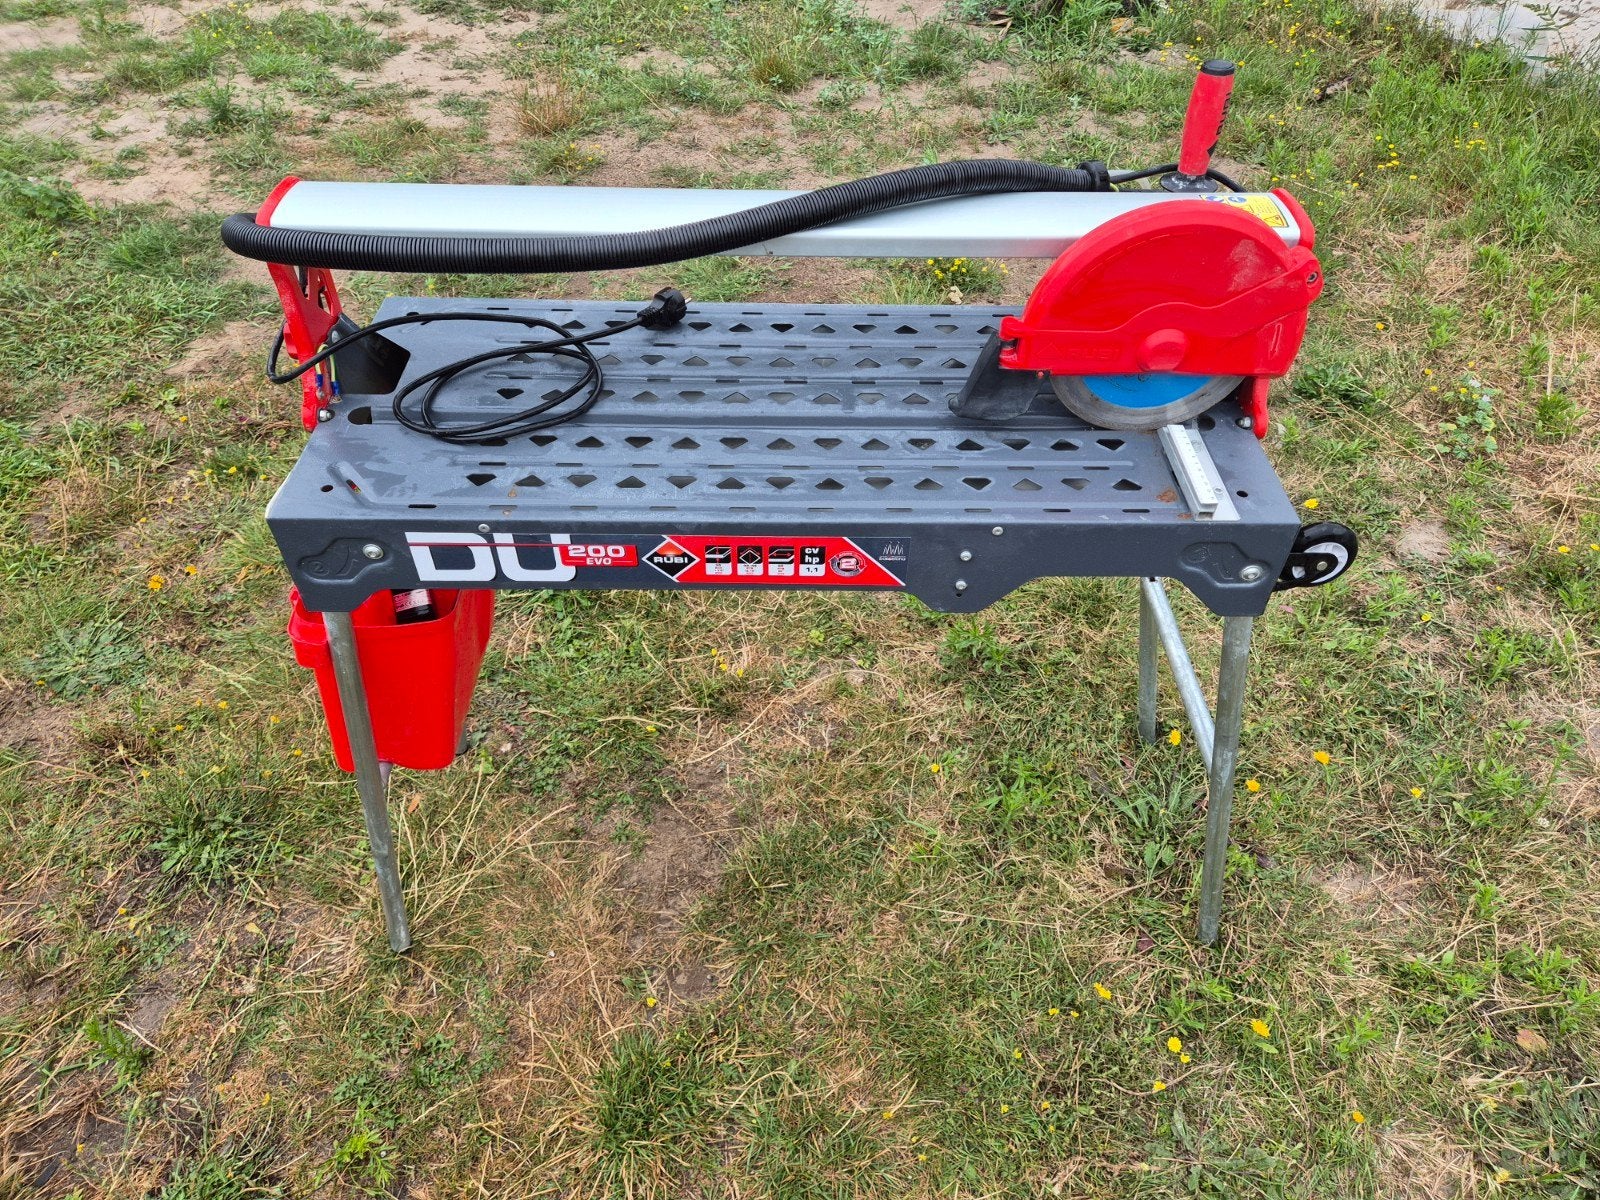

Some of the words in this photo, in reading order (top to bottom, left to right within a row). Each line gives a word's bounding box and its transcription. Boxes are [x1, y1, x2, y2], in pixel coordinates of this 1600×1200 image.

[568, 545, 625, 558] 200
[404, 532, 576, 582] DU
[586, 557, 612, 565] EVO
[653, 556, 689, 564] RUBI
[804, 555, 820, 564] hp
